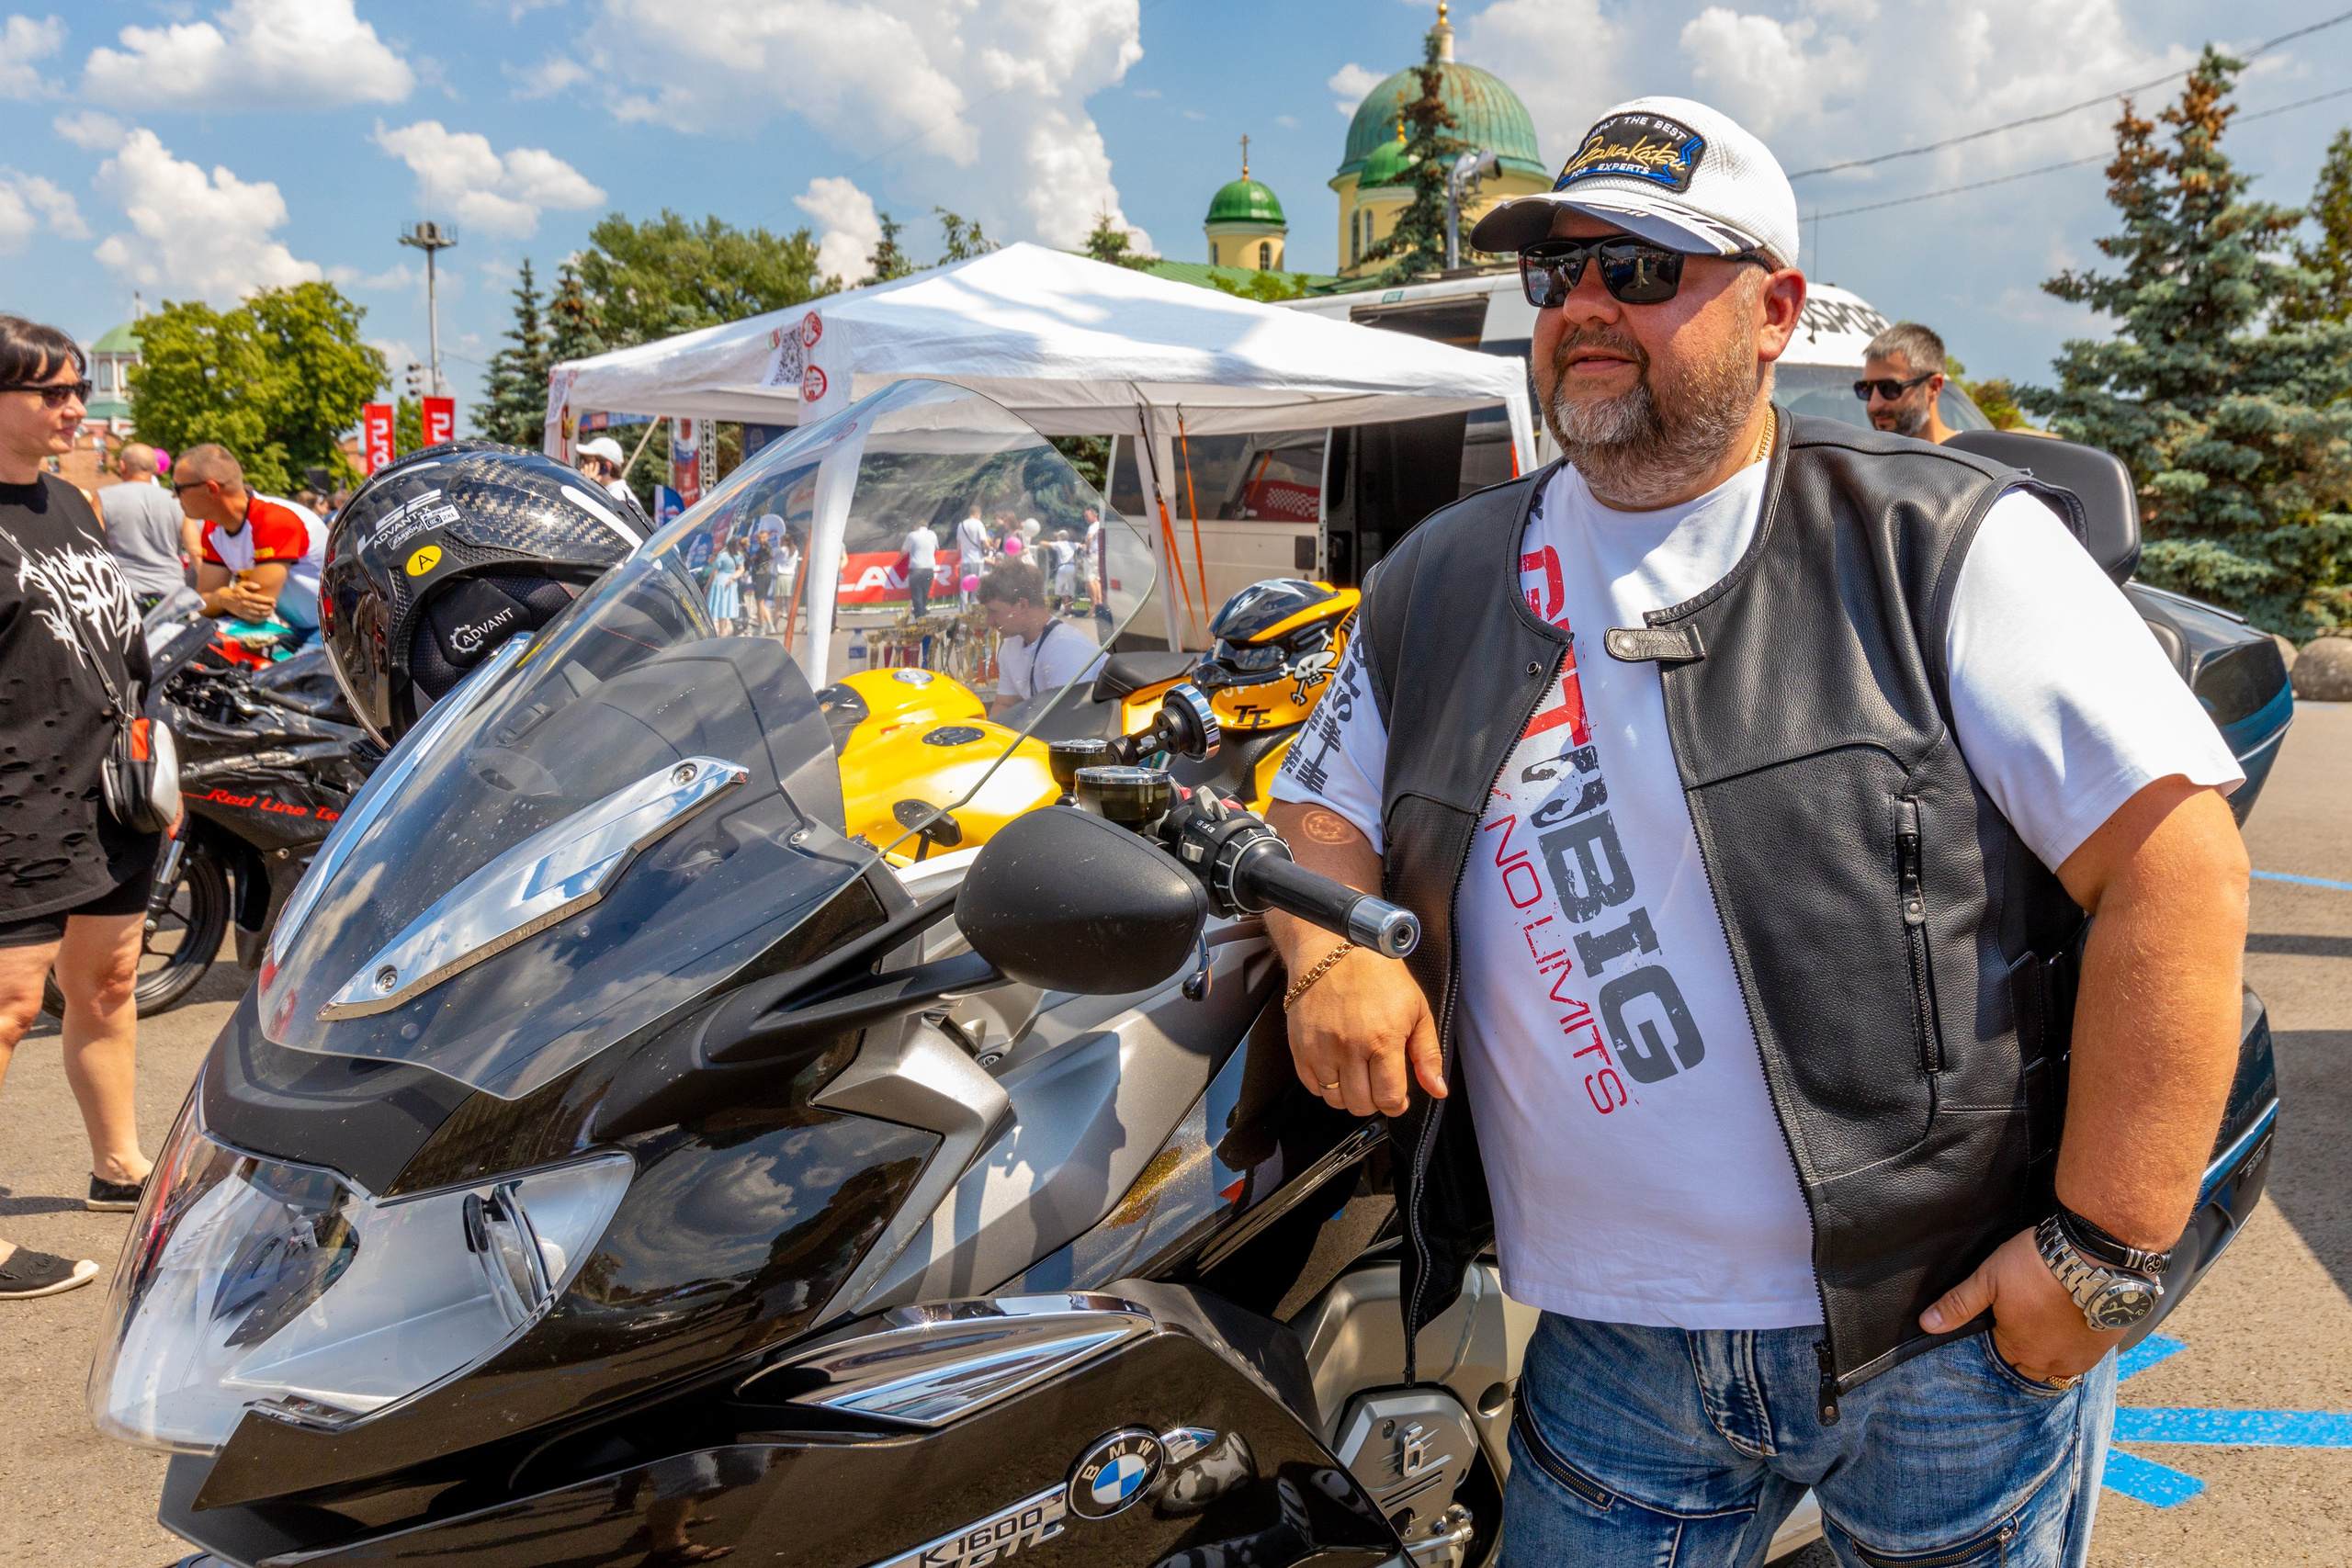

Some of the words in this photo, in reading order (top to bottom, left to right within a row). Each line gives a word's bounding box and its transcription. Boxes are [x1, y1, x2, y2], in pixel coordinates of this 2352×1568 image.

[1624, 116, 1649, 126] THE
[1654, 120, 1687, 141] BEST
[1597, 163, 1651, 175] EXPERTS
[357, 489, 441, 555] LS2
[373, 505, 431, 549] ADVANT-X
[417, 554, 434, 570] A
[462, 607, 514, 646] ADVANT
[1233, 704, 1272, 730] TT
[206, 788, 258, 807] Red
[260, 797, 309, 817] Line
[1484, 814, 1543, 909] NO
[1522, 915, 1628, 1114] LIMITS
[1537, 808, 1706, 1085] BIG
[1081, 1438, 1155, 1481] BMW
[1403, 1424, 1424, 1477] 6
